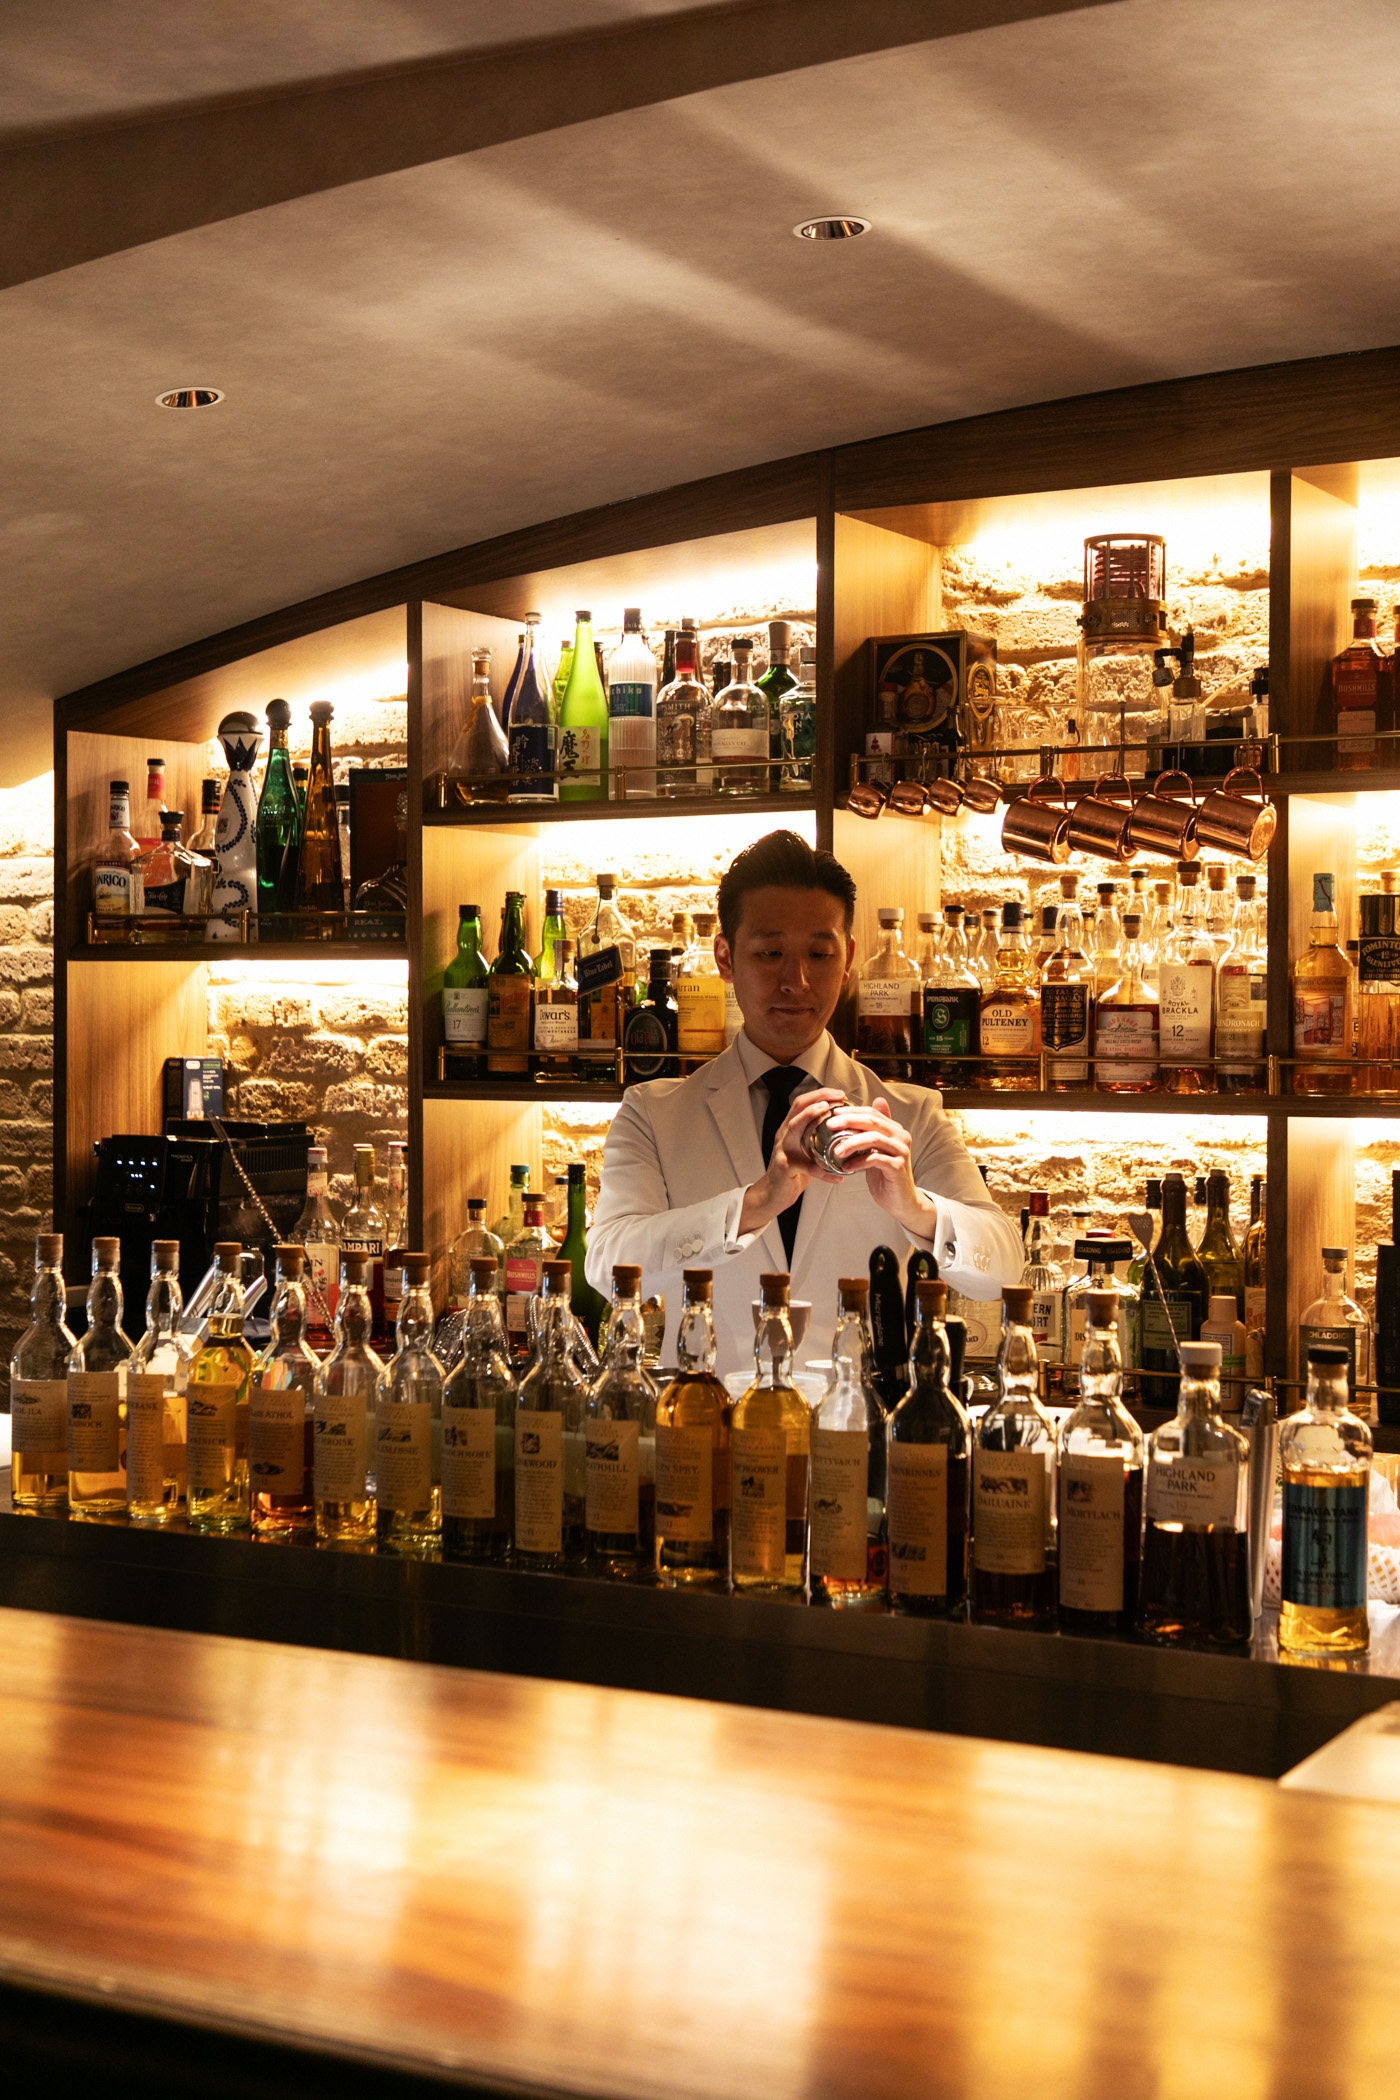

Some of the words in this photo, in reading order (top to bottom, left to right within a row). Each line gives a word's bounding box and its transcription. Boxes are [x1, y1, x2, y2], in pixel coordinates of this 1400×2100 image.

[1338, 684, 1375, 692] BUSHMILLS
[992, 1009, 1012, 1018] OLD
[453, 1020, 461, 1029] 17
[982, 1018, 1028, 1026] PULTENEY
[1172, 1024, 1184, 1037] 12
[982, 1036, 989, 1046] 12
[342, 1243, 381, 1255] AMPARI
[265, 1411, 294, 1420] ATHOL
[1155, 1466, 1216, 1483] HIGHLAND
[1167, 1480, 1198, 1493] PARK
[1065, 1505, 1121, 1520] MORTLACH
